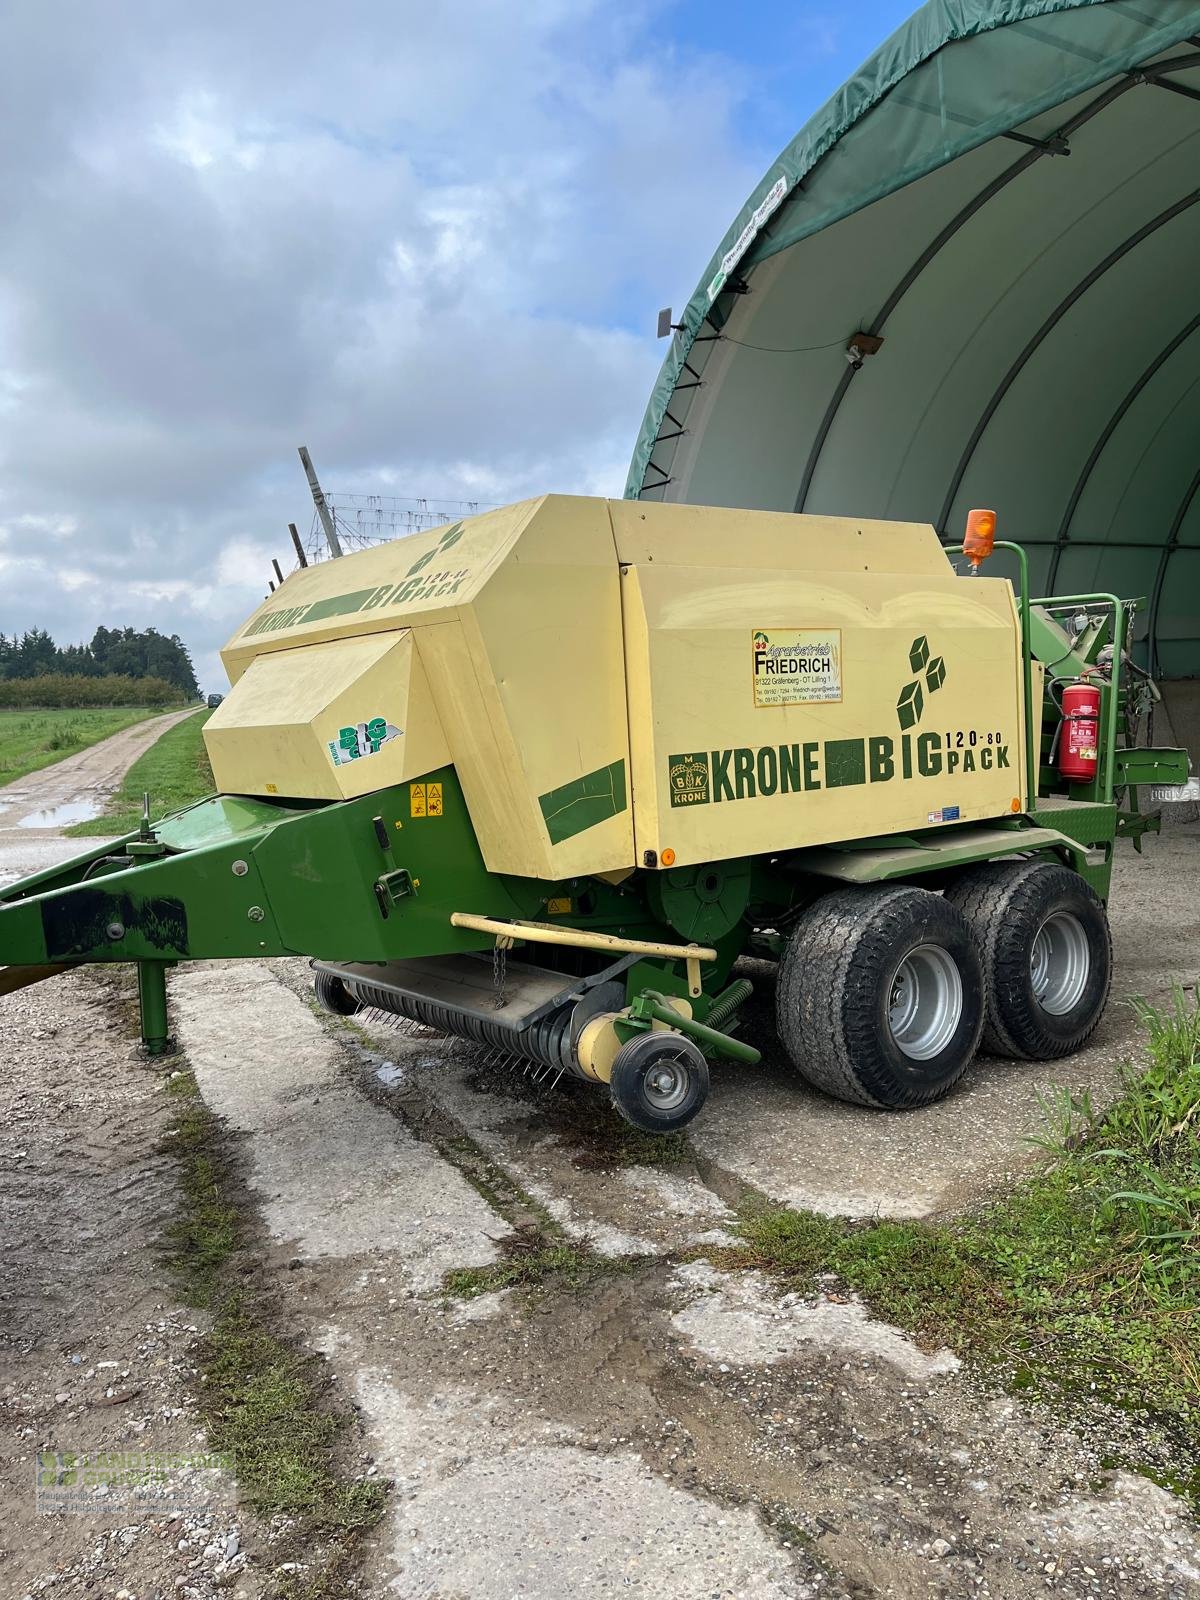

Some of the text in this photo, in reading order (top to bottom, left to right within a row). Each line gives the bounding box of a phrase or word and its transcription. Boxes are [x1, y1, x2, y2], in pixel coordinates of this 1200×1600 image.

[360, 576, 424, 612] BIG
[411, 577, 466, 601] PACK
[754, 650, 831, 675] FRIEDRICH
[766, 642, 831, 660] Agrarbetrieb
[339, 717, 387, 750] BIG
[348, 740, 381, 759] CUT
[684, 755, 693, 764] M
[947, 745, 1011, 775] PACK
[711, 732, 943, 803] KRONE BIG
[674, 791, 707, 804] KRONE
